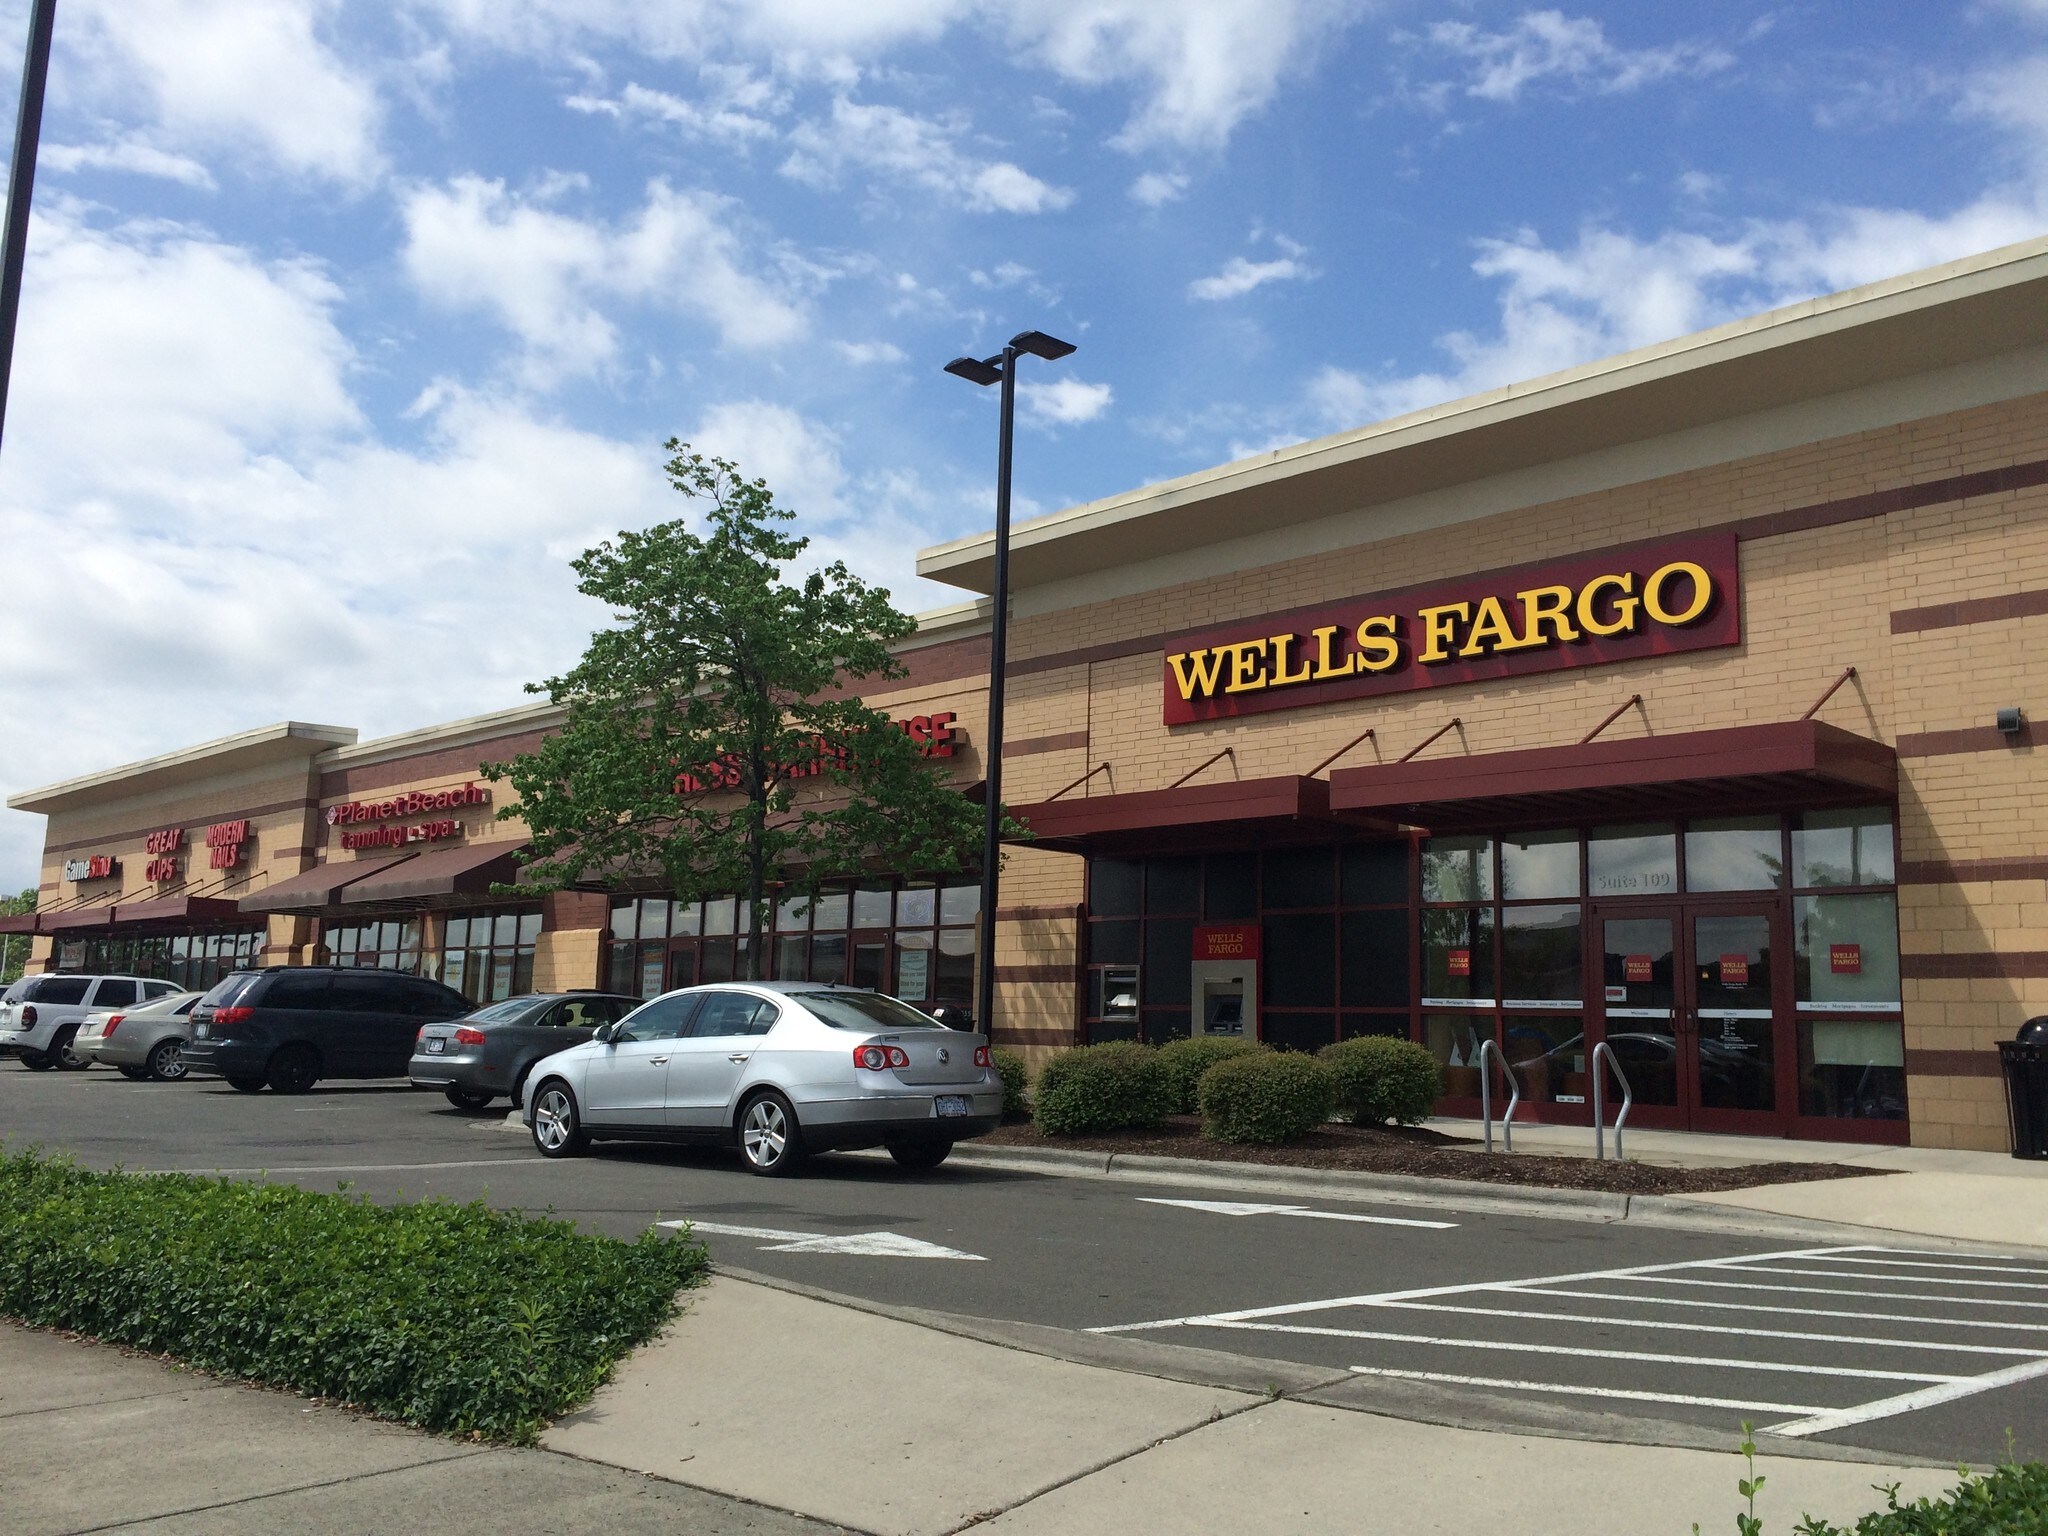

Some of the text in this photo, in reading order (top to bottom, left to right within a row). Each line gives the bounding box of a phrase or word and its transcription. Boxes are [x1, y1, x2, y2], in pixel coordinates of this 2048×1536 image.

[1166, 561, 1712, 701] WELLS FARGO
[338, 782, 480, 824] Planet Beach
[145, 828, 183, 855] GREAT
[206, 819, 248, 848] MODERN
[340, 819, 455, 849] tanning spa
[64, 855, 113, 882] GameStop
[145, 857, 177, 882] CLIPS
[209, 844, 239, 869] NAILS
[1598, 872, 1670, 889] Suite 109
[1207, 933, 1244, 944] WELLS
[1207, 944, 1244, 954] FARGO
